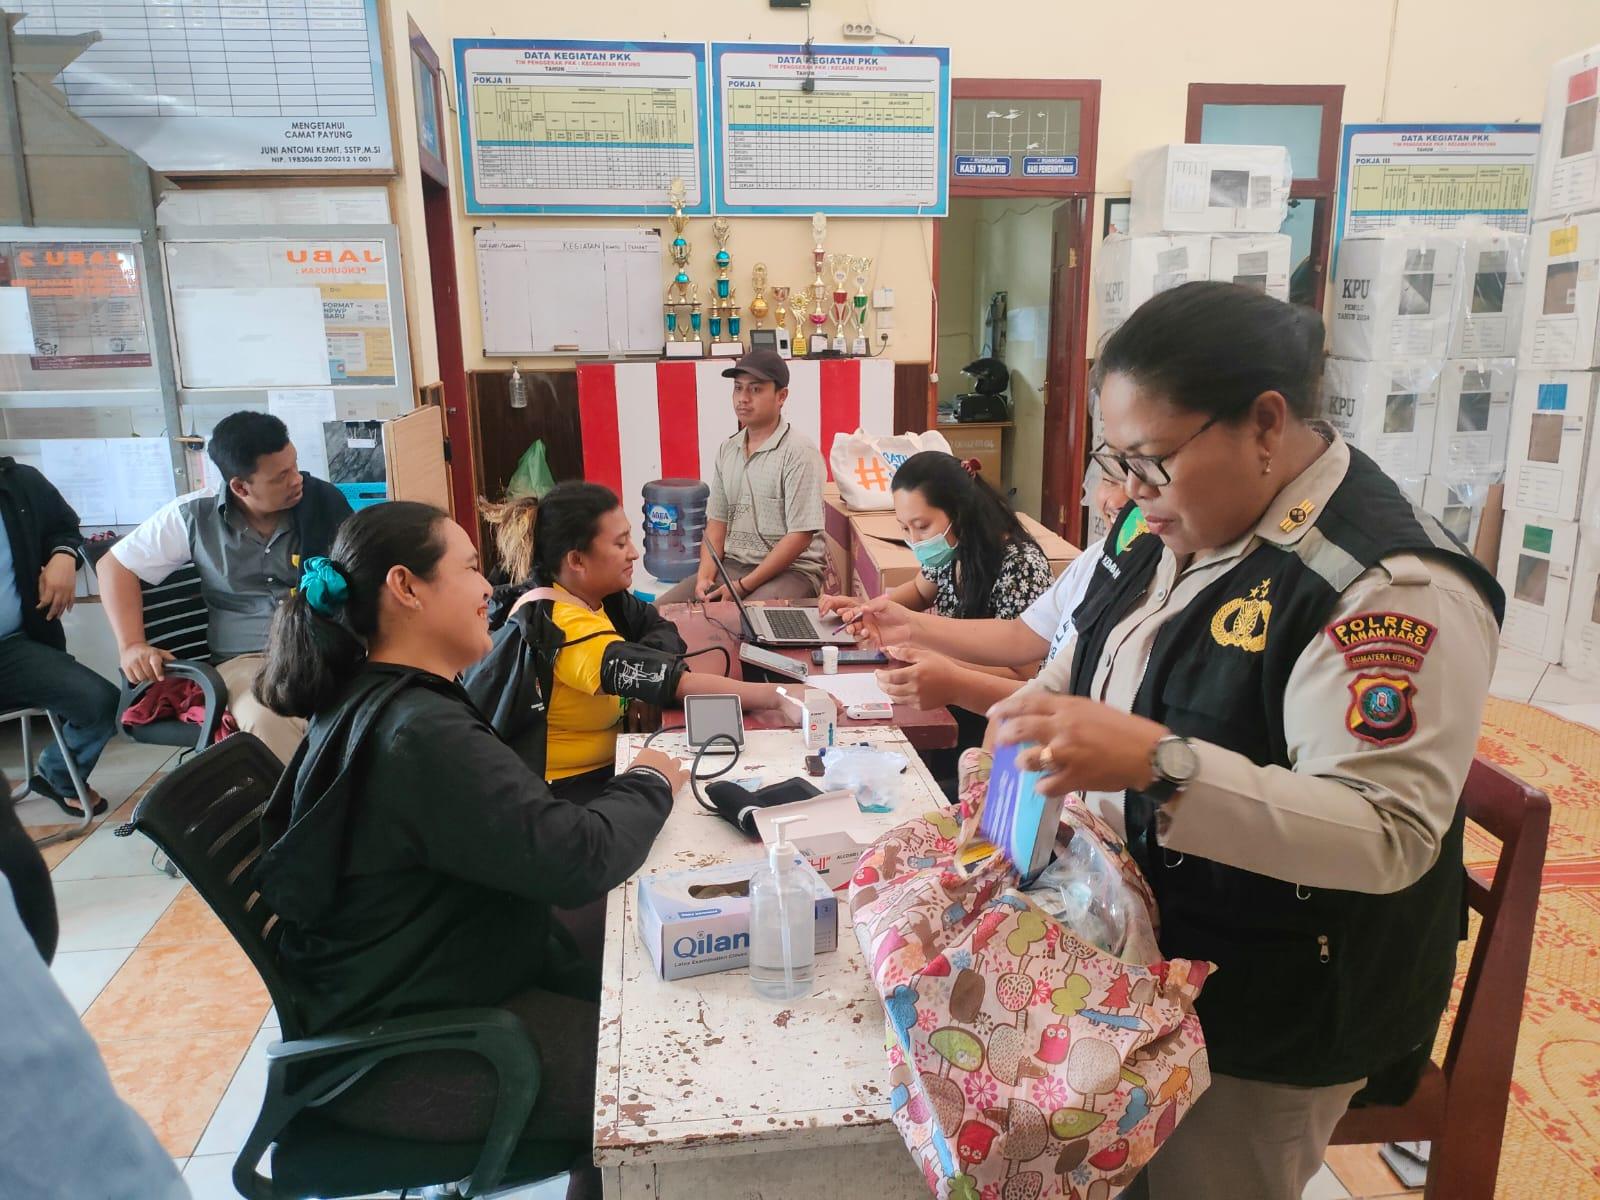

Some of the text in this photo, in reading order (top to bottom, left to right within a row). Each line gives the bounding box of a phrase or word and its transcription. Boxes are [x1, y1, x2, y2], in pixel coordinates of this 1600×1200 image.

[524, 51, 631, 61] DATA KEGIATAN PKK
[777, 56, 802, 64] DATA
[805, 56, 855, 65] KEGIATAN
[473, 76, 503, 84] POKJA
[728, 80, 756, 88] POKJA
[291, 122, 345, 130] MENGETAHUI
[284, 130, 353, 139] CAMAT PAYUNG
[1401, 134, 1490, 142] DATA KEGIATAN PKK
[260, 146, 279, 155] JUNI
[281, 146, 314, 154] ANTOMI
[959, 164, 1007, 174] KASI TRANTIB
[562, 242, 601, 250] KEGIATAN
[1104, 281, 1125, 304] KPU
[1342, 278, 1371, 300] KPU
[1328, 395, 1356, 418] KPU
[1335, 616, 1428, 637] POLRES
[1341, 628, 1425, 646] TANAH KARO
[1351, 653, 1416, 665] SUMATERA UTARA
